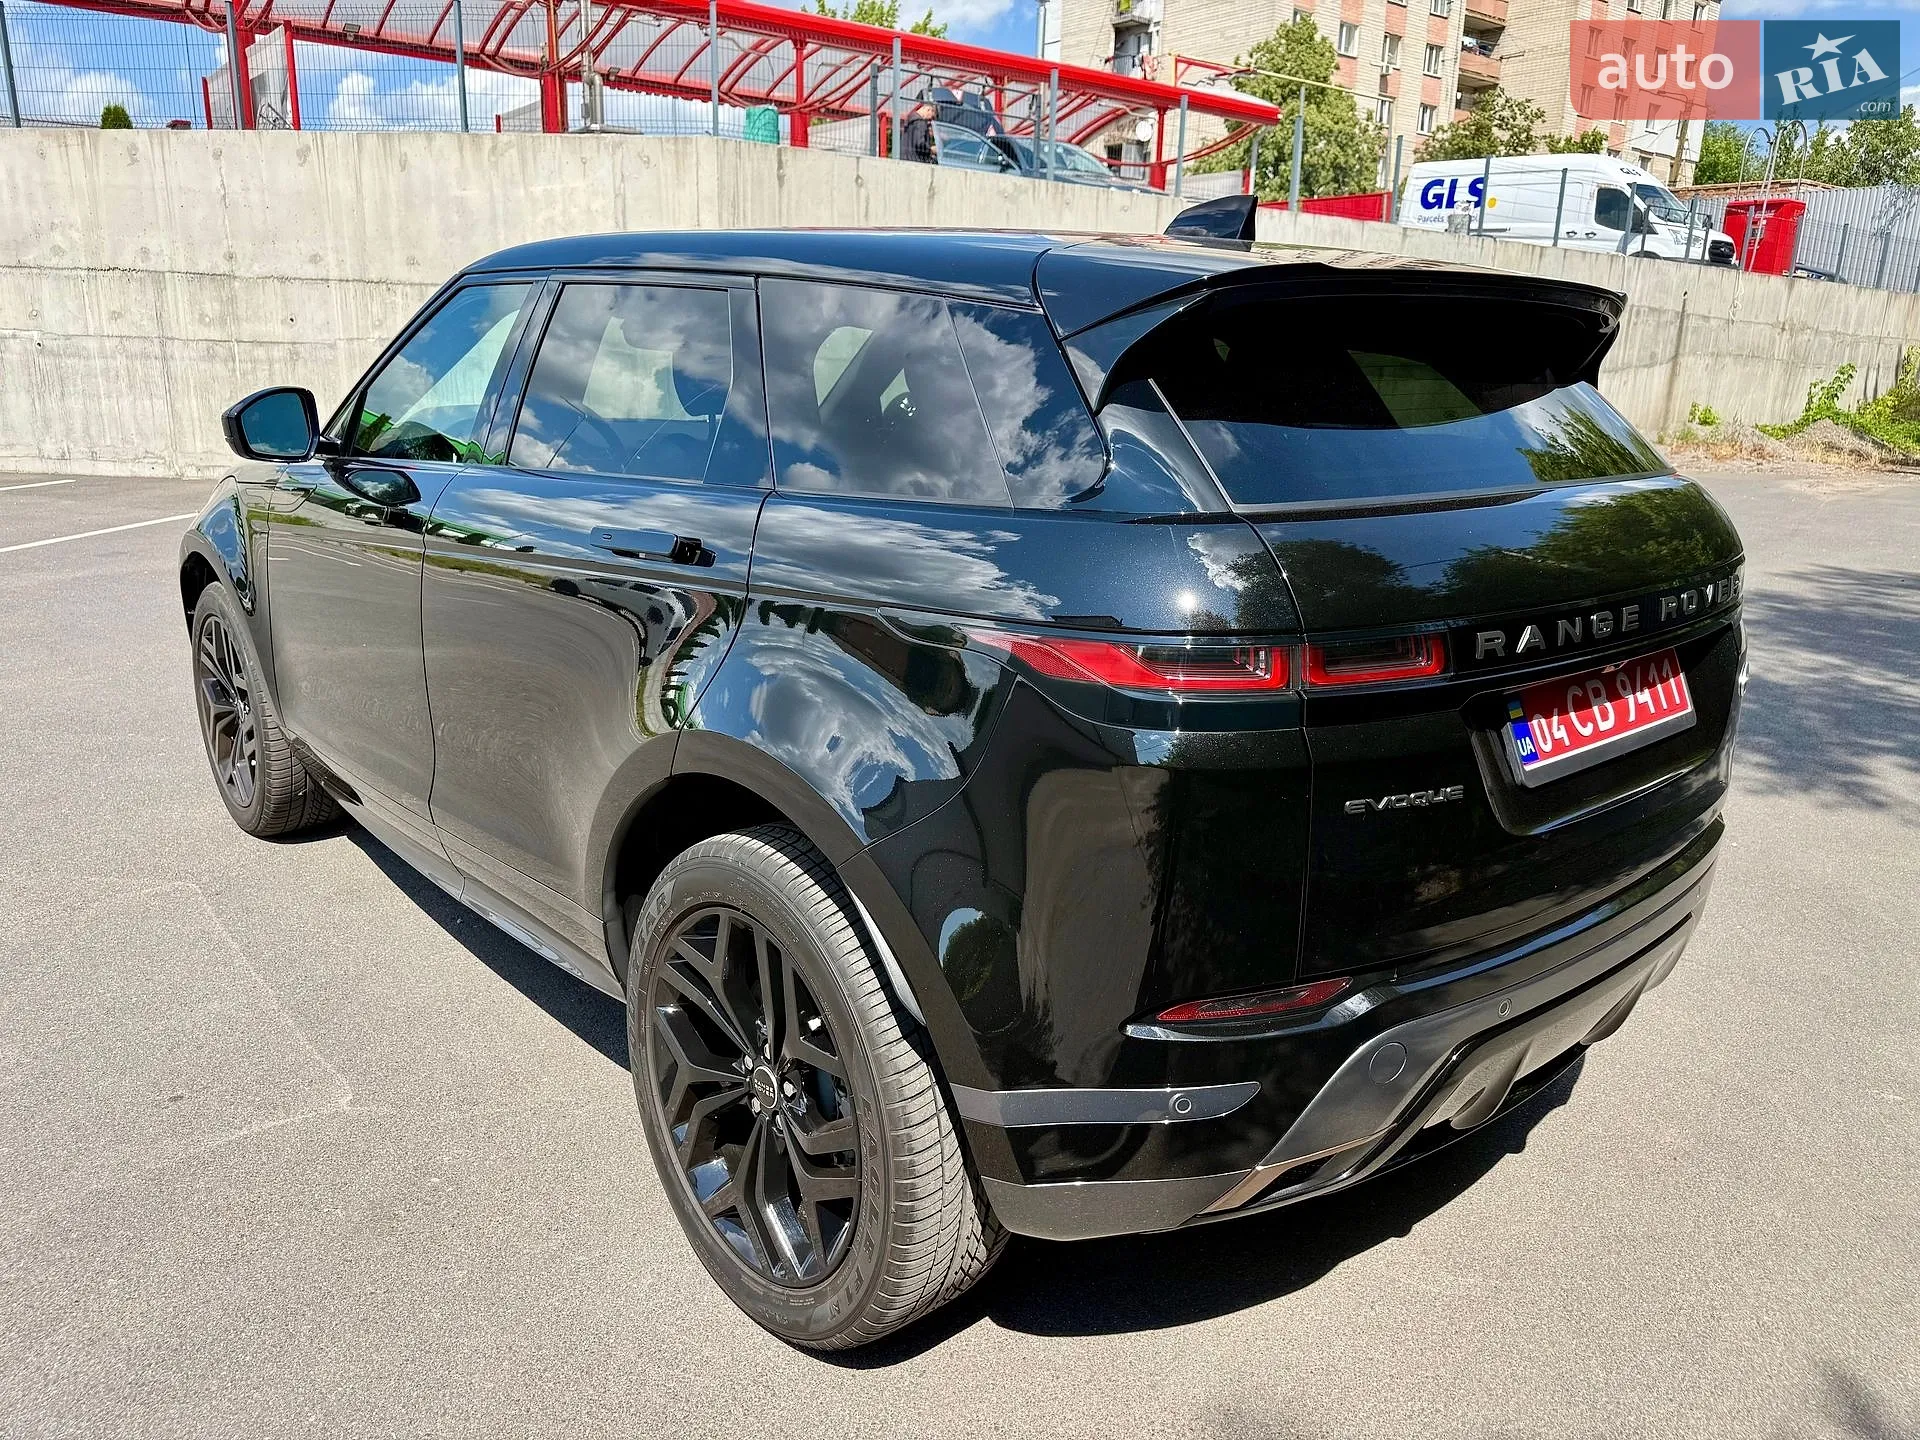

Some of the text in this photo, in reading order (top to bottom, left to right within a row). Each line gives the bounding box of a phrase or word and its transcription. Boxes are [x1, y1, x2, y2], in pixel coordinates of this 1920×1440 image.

[1475, 573, 1740, 660] RANGE ROVER
[1532, 658, 1681, 753] 04 CB 9411
[1516, 737, 1535, 756] UA
[1344, 785, 1464, 815] EVOQUE
